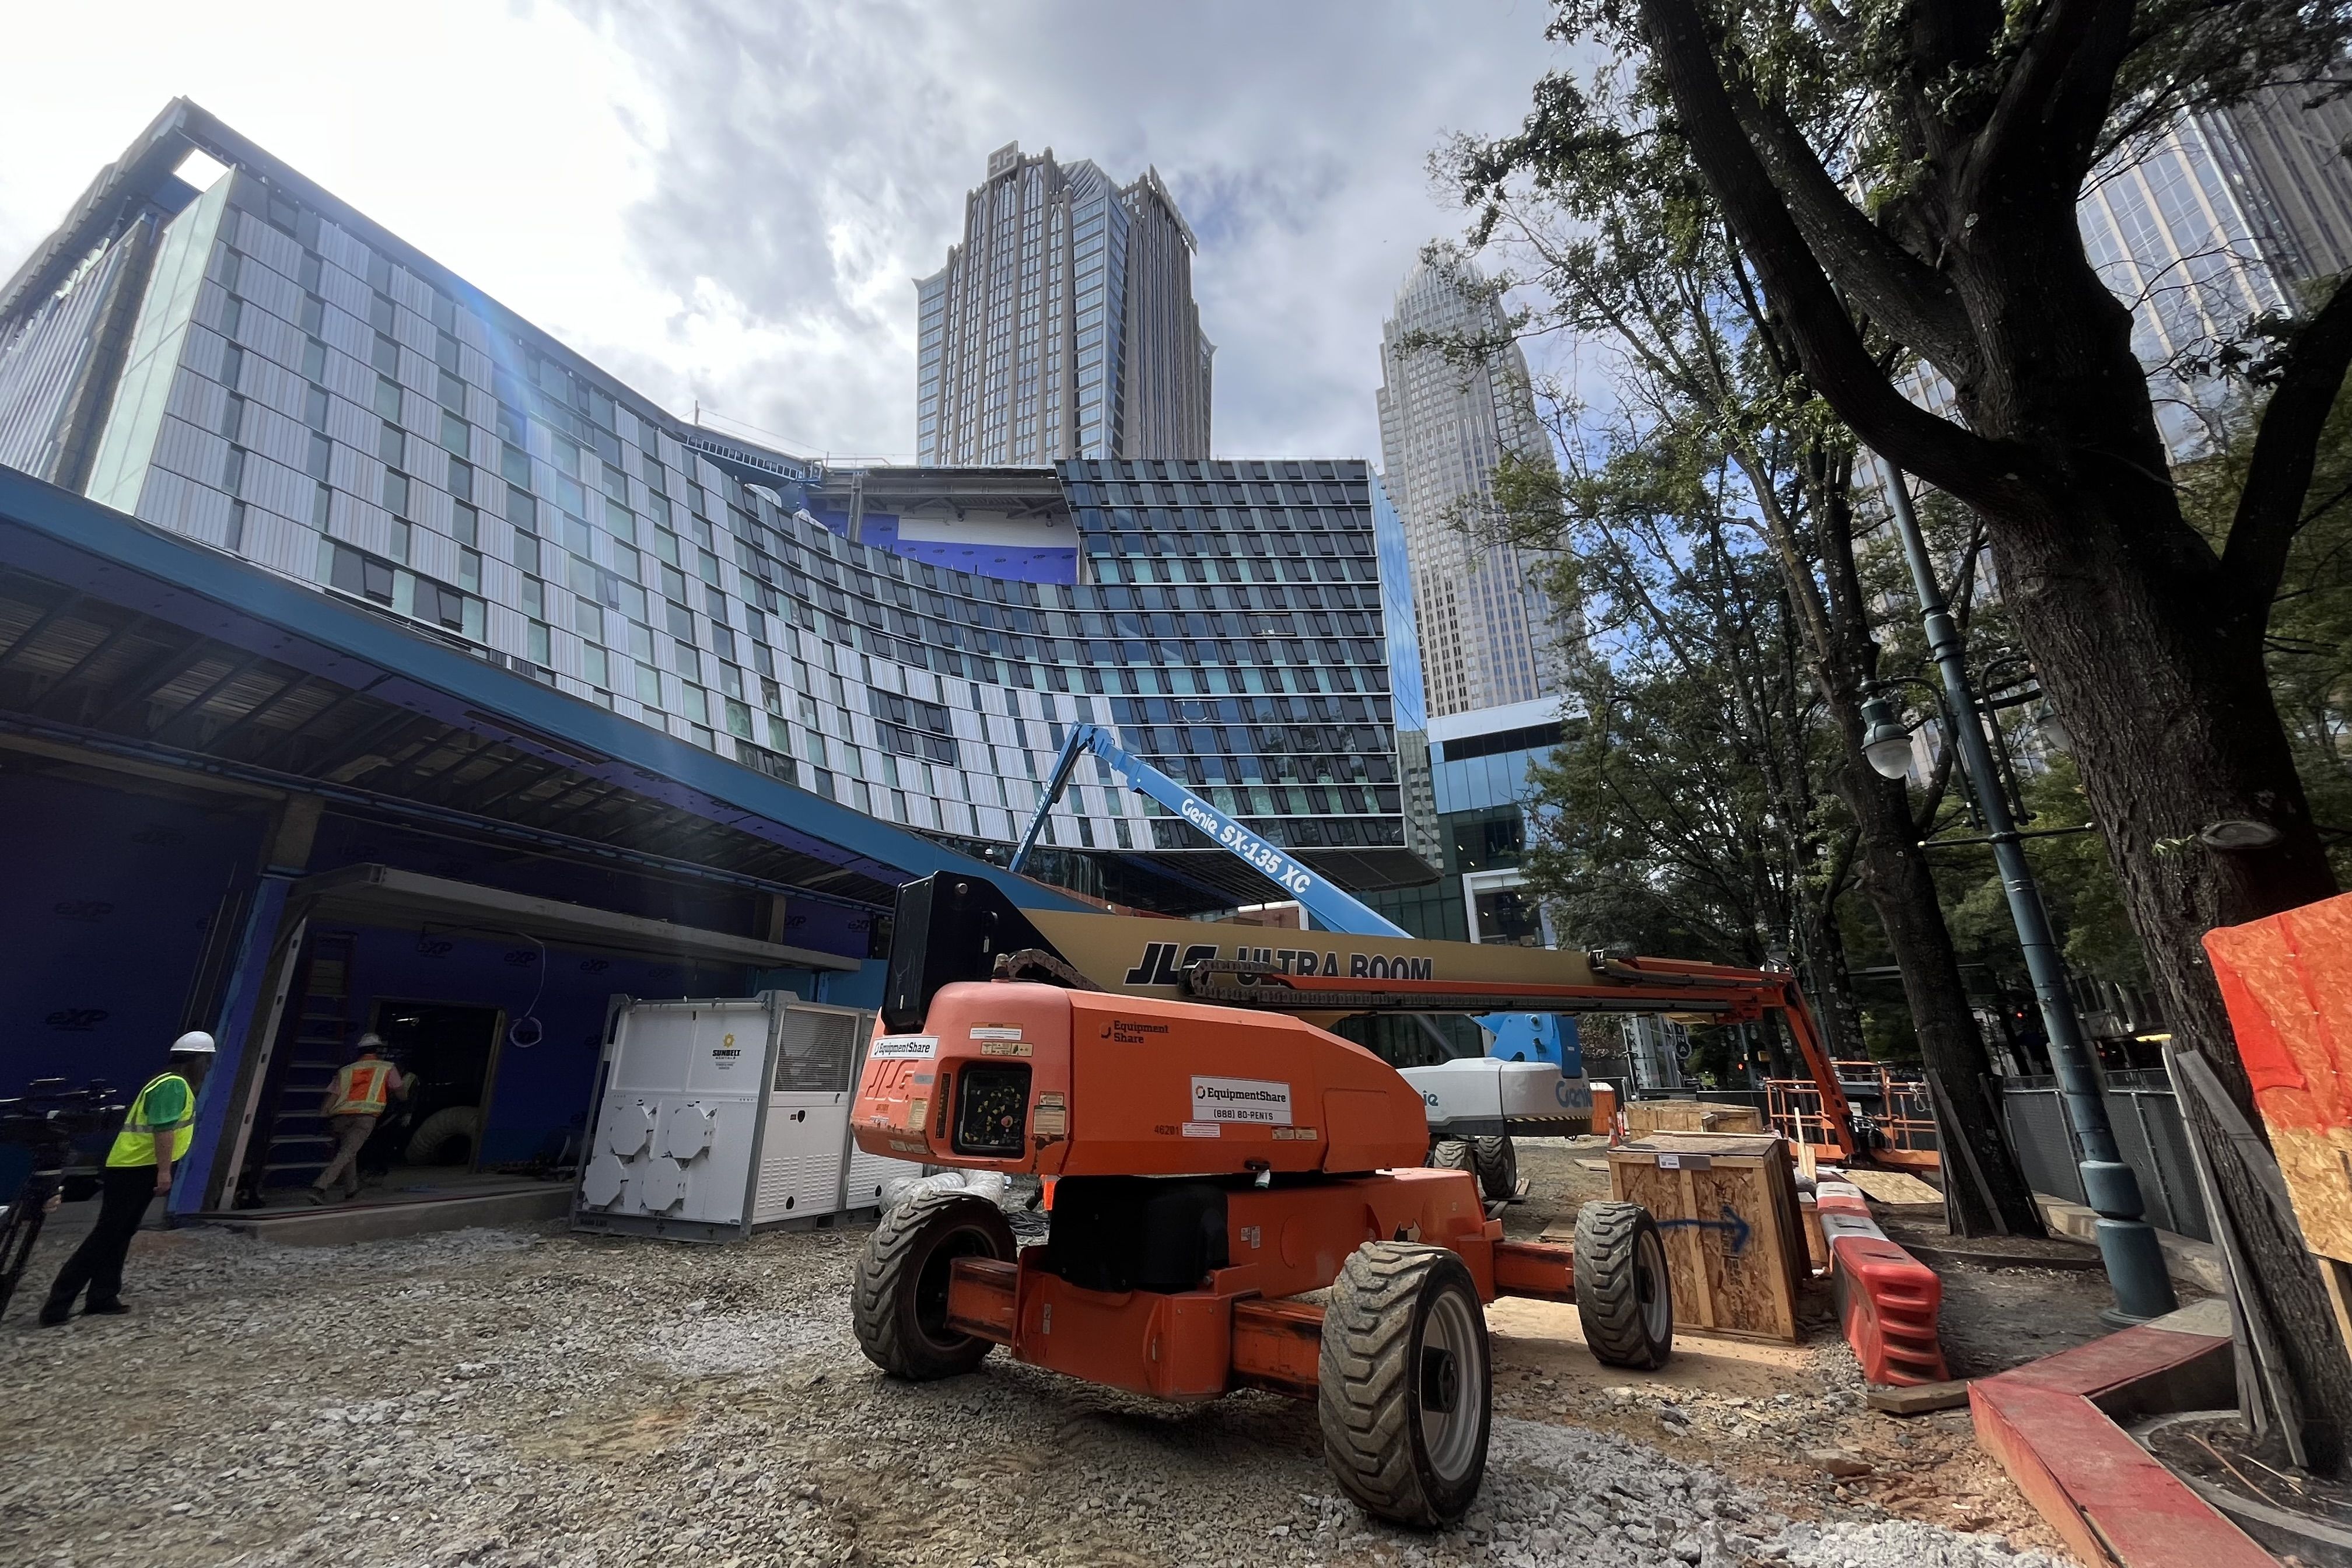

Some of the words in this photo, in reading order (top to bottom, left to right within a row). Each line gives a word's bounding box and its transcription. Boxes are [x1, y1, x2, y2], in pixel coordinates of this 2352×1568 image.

[1181, 798, 1218, 835] Genie
[1220, 825, 1283, 874] SX-135
[1278, 864, 1311, 894] XC
[1349, 952, 1433, 980] BOOM
[1113, 1020, 1170, 1034] Equipment
[1114, 1032, 1144, 1044] Share
[878, 1041, 930, 1055] EquipmentShare
[1207, 1087, 1286, 1102] EquipmentShare
[1213, 1108, 1236, 1119] (888)
